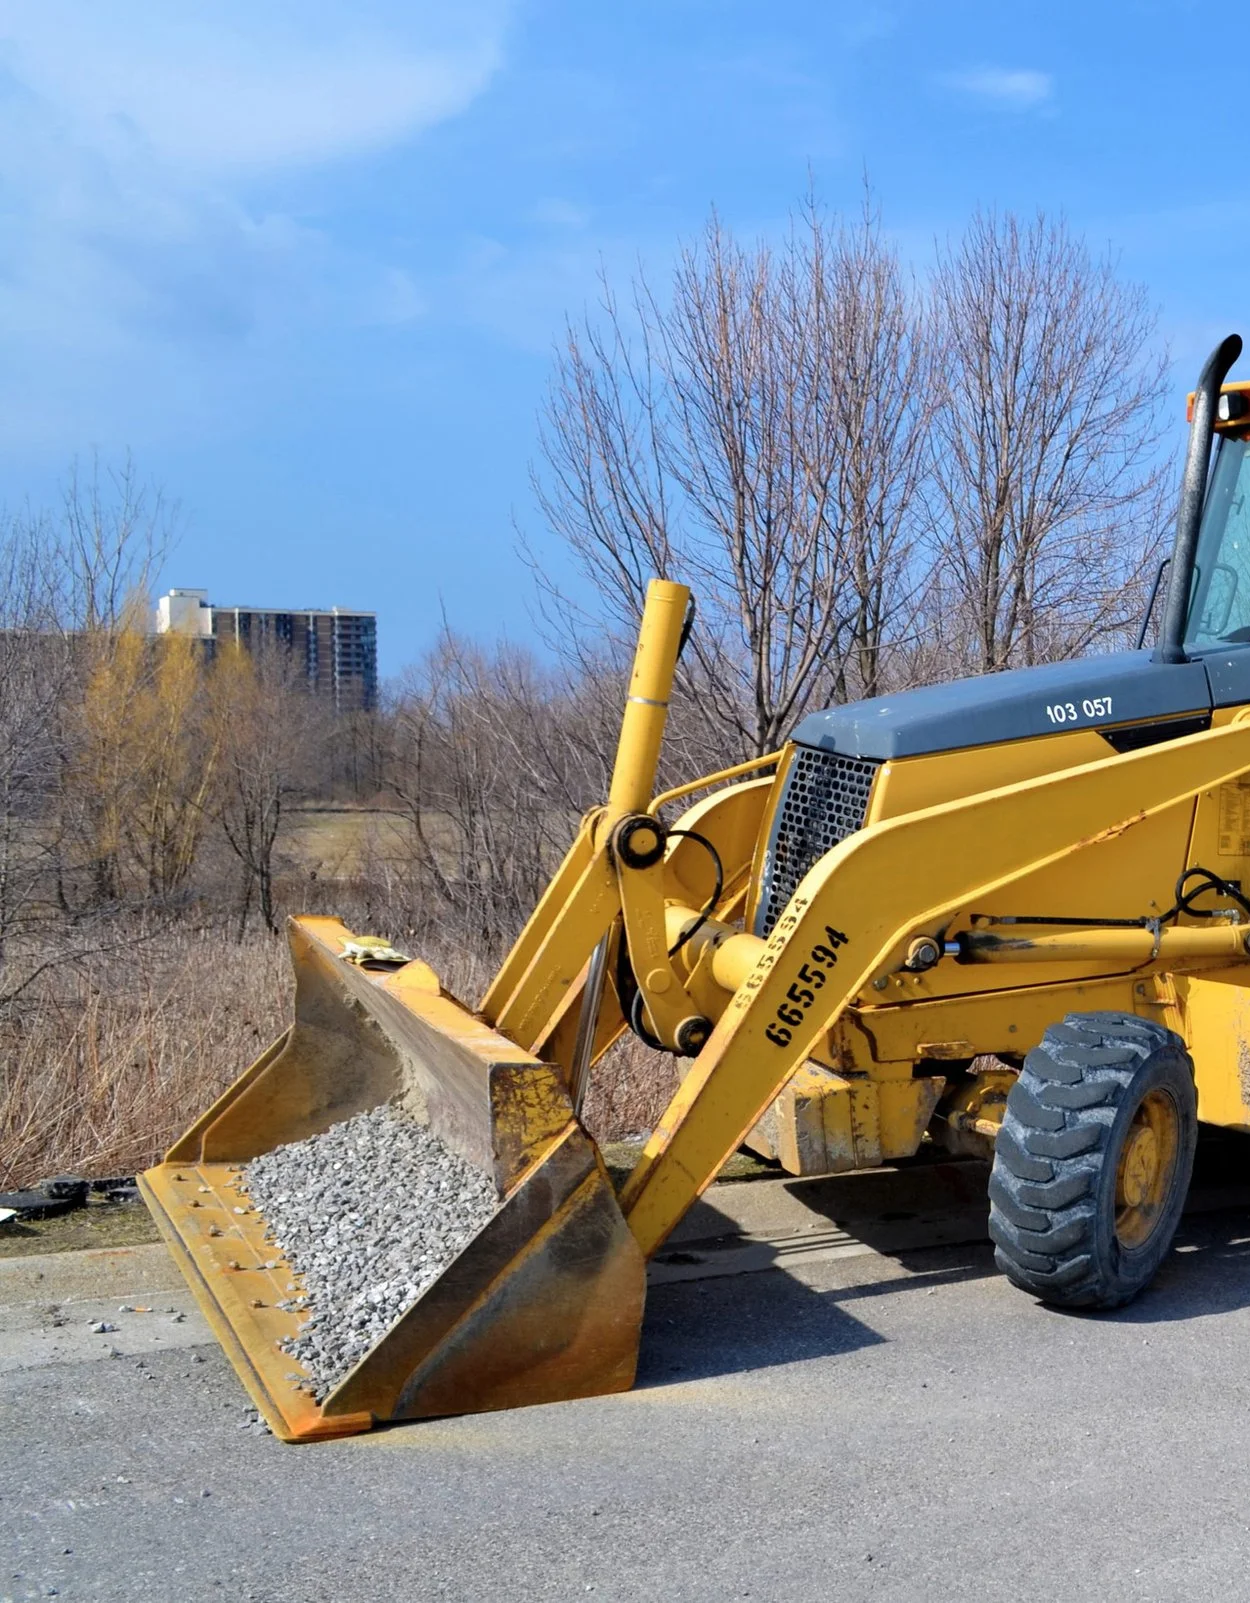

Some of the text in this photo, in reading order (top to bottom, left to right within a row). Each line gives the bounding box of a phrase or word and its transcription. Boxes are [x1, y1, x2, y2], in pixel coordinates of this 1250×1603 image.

[1046, 697, 1113, 724] 103 057
[765, 925, 849, 1048] 665594
